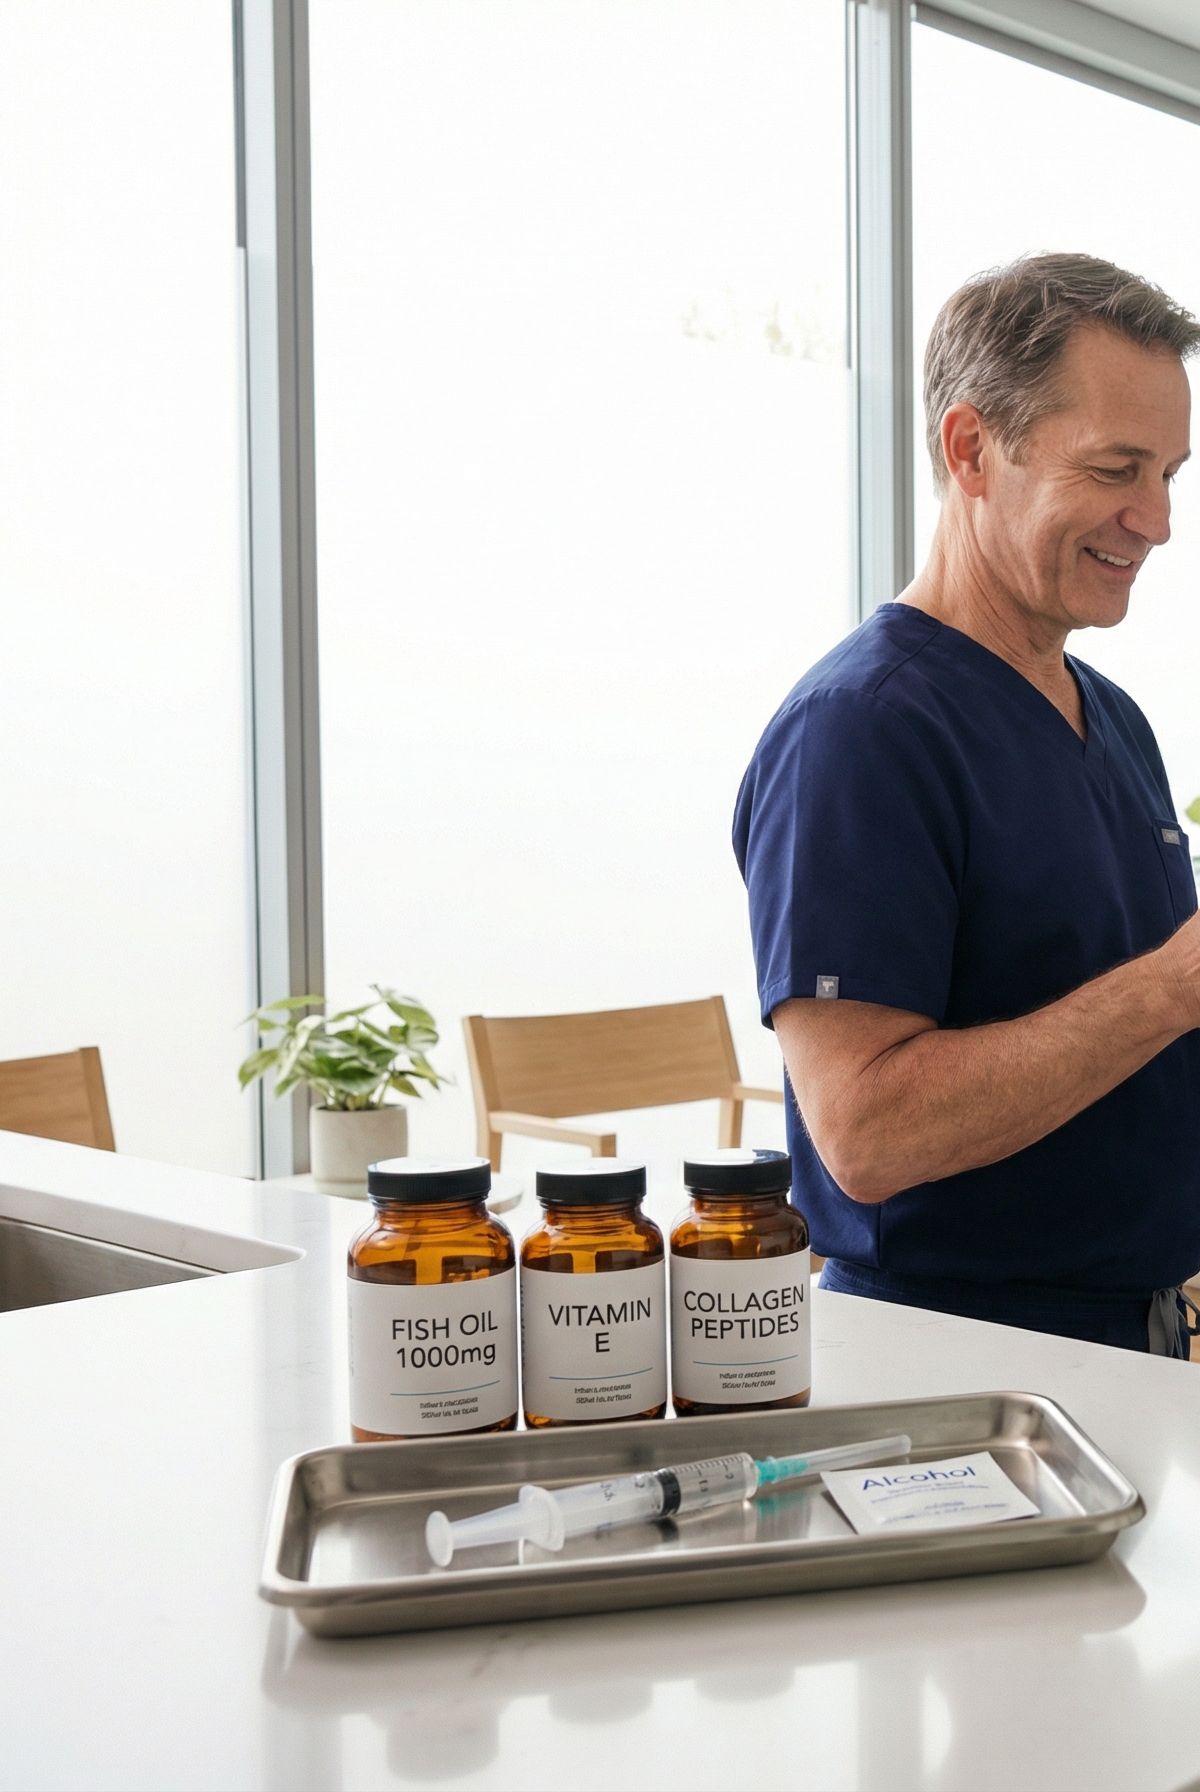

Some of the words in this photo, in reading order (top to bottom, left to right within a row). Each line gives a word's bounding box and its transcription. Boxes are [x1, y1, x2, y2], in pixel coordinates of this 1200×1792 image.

[548, 1297, 651, 1327] VITAMIN
[684, 1283, 804, 1313] COLLAGEN
[392, 1317, 450, 1341] FISH
[459, 1310, 498, 1336] OIL
[691, 1311, 799, 1340] PEPTIDES
[396, 1343, 496, 1369] 1000mg
[595, 1332, 610, 1353] E
[862, 1466, 977, 1491] Alcohol
